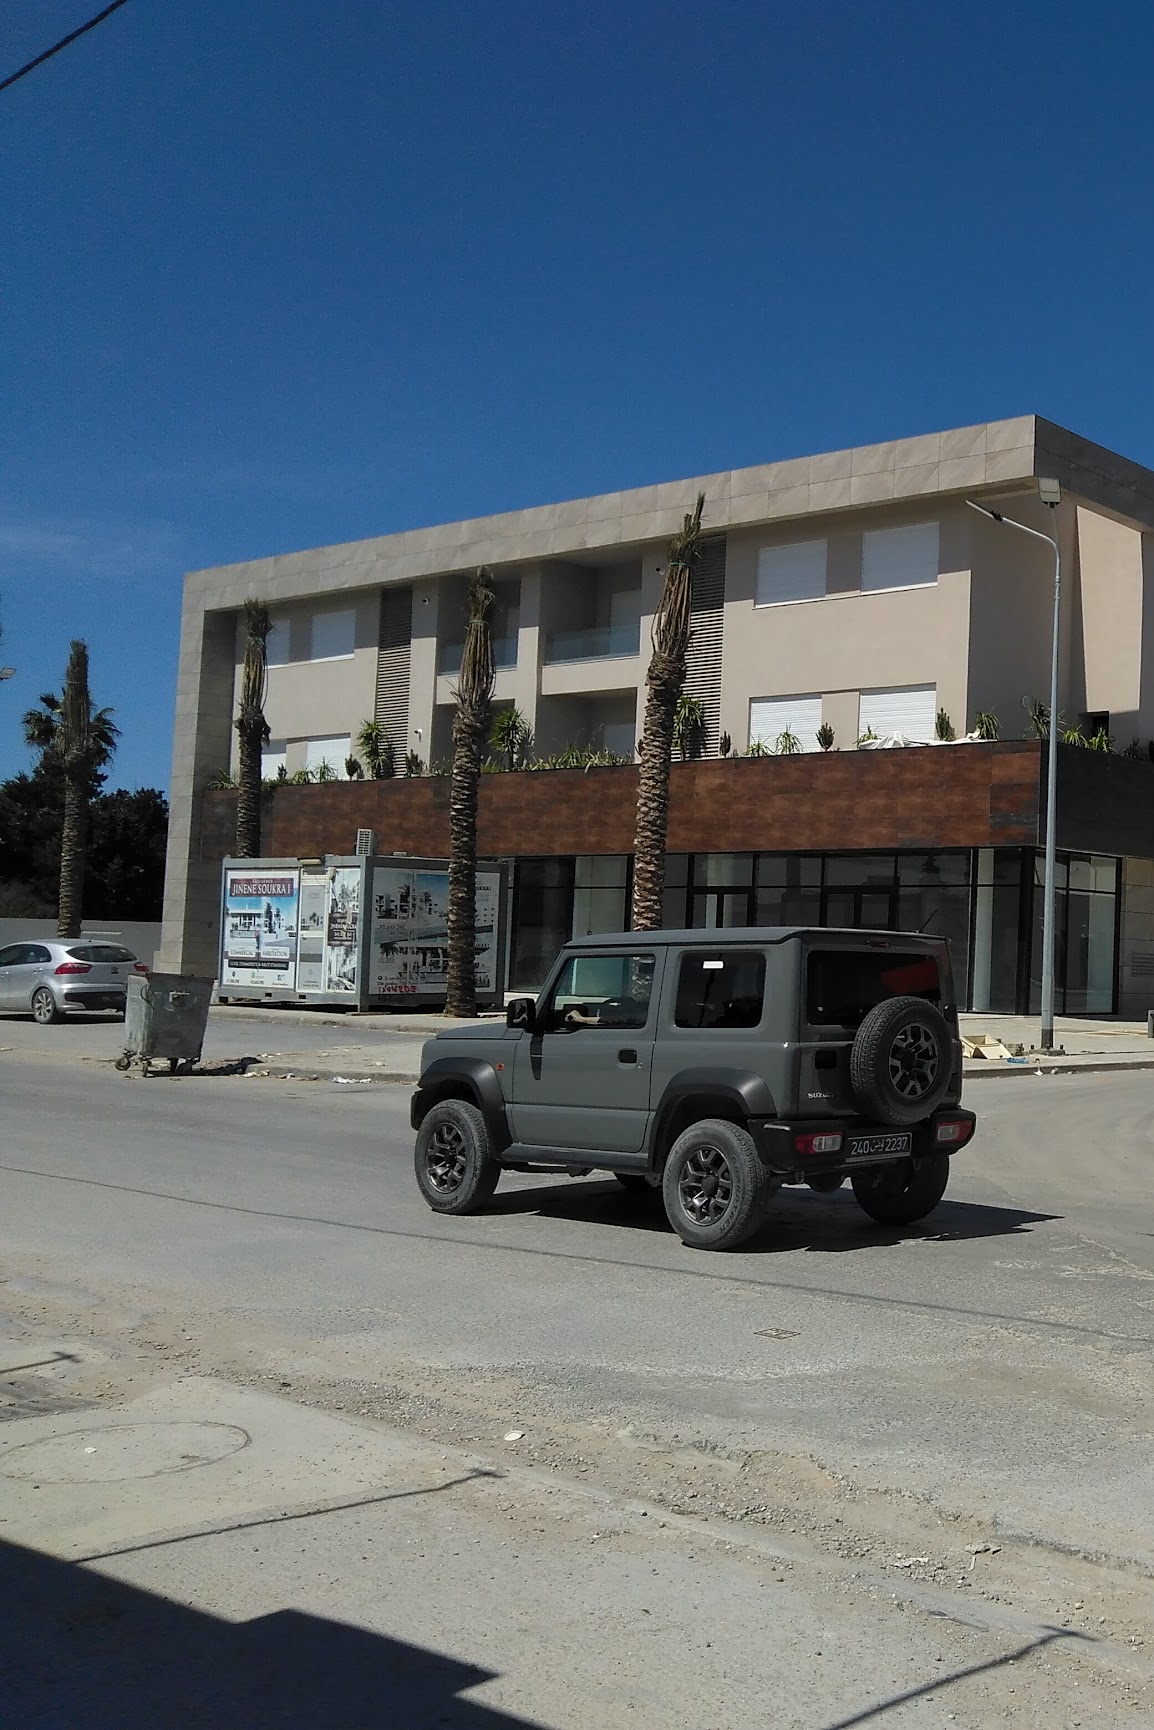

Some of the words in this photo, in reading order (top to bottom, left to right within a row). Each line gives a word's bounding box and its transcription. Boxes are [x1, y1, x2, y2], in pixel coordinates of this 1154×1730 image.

[232, 884, 257, 895] JINENE
[258, 884, 286, 895] SOUKRA
[851, 1140, 869, 1155] 240
[885, 1136, 909, 1152] 2237
